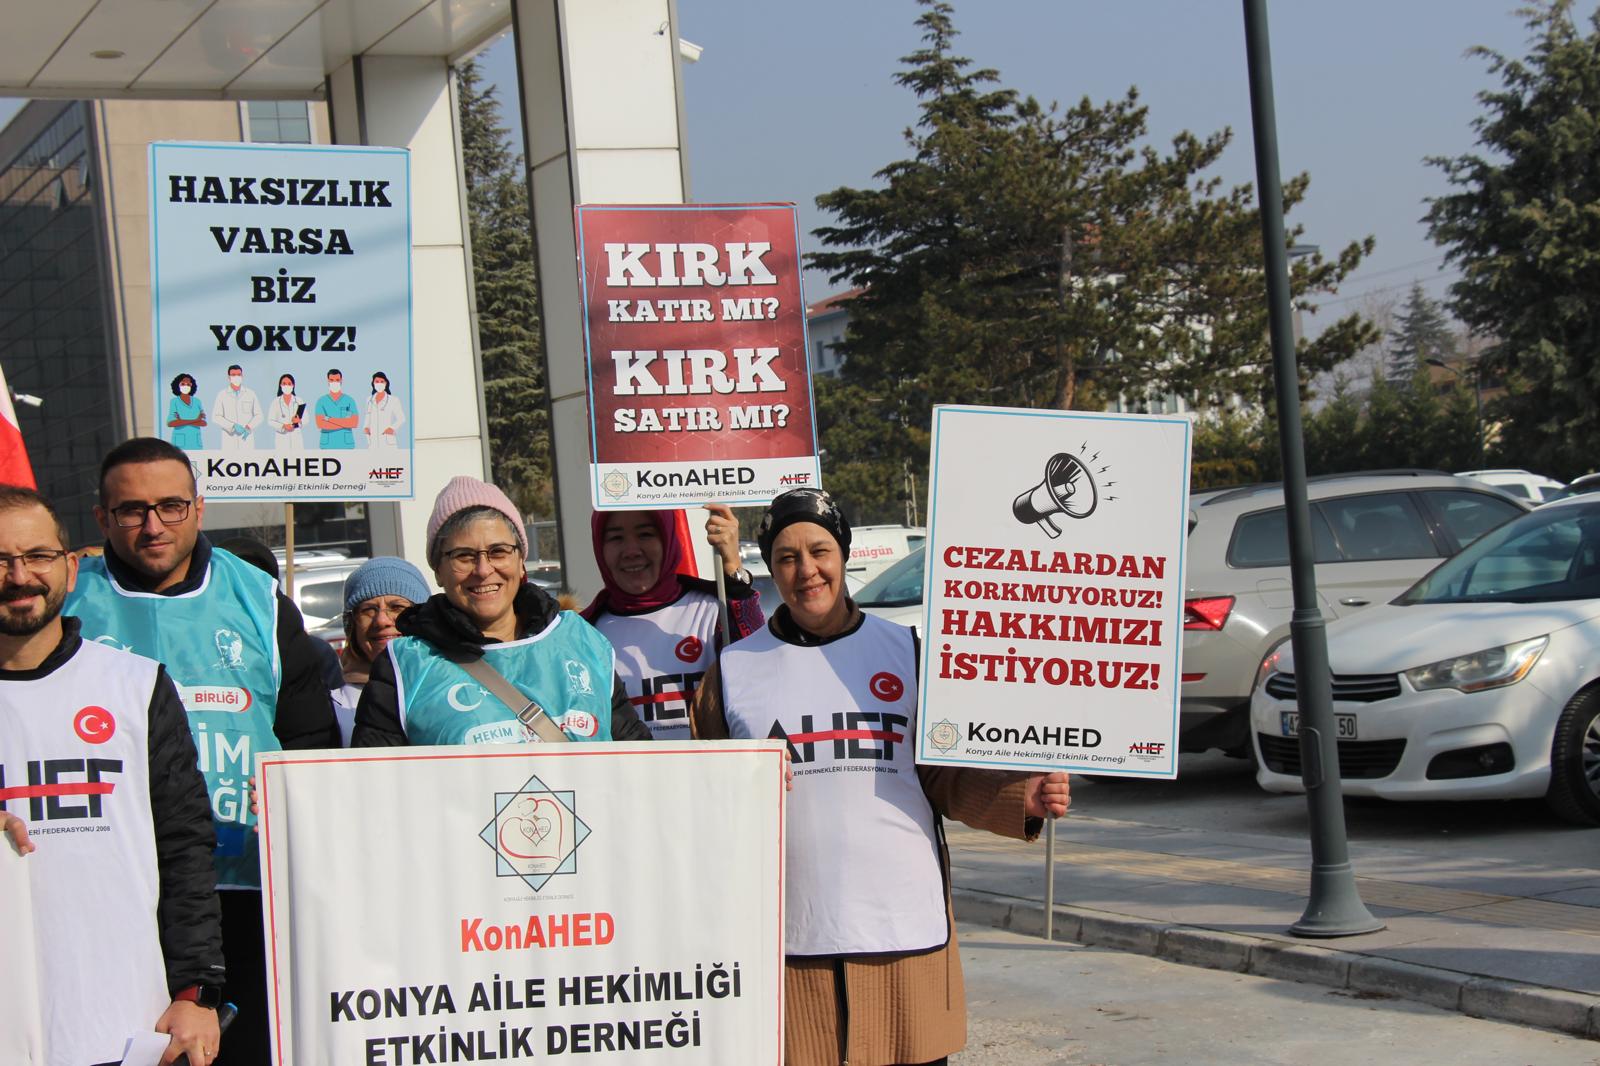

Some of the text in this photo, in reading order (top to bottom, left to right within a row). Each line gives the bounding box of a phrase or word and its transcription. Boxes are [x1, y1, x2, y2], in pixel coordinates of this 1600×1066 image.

[169, 175, 392, 207] HAKSIZLIK
[210, 226, 353, 255] VARSA
[604, 241, 777, 287] KIRK
[251, 267, 316, 304] BİZ
[607, 297, 779, 323] KATIR MI?
[210, 324, 357, 352] YOKUZ!
[611, 347, 786, 396] KIRK
[613, 404, 790, 433] SATIR MI?
[207, 458, 341, 477] KonAHED
[368, 467, 404, 479] AHEF
[636, 467, 755, 488] KonAHED
[779, 472, 811, 485] AHEF
[206, 484, 234, 492] Konya
[237, 483, 252, 491] Aile
[254, 483, 296, 492] Hekimliği
[299, 483, 330, 491] Etkinlik
[332, 483, 367, 492] Derneği
[636, 492, 661, 500] Konya
[717, 489, 746, 497] Etkinlik
[850, 545, 893, 559] enigün
[943, 545, 1167, 579] CEZALARDAN
[944, 579, 1163, 609] KORKMUYORUZ!
[941, 608, 1163, 646] HAKKIMIZI
[939, 643, 1161, 690] İSTİYORUZ!
[194, 690, 239, 705] BİRLİĞİ
[472, 726, 513, 743] HEKİM
[967, 721, 1102, 748] KonAHED
[1339, 717, 1354, 736] 50
[965, 747, 993, 757] Konya
[994, 748, 1012, 757] Aile
[1056, 752, 1090, 761] Etkinlik
[1091, 754, 1126, 764] Derneği
[1129, 742, 1165, 755] AHEF
[804, 765, 843, 776] DERNEKLERİ
[843, 765, 887, 773] FEDERASYONU
[28, 826, 41, 836] ERİ
[42, 826, 95, 836] FEDERASYONU
[461, 911, 615, 953] KonAHED
[330, 961, 741, 1023] KONYA AİLE HEKİMLİĞİ
[365, 1010, 701, 1066] ETKİNLİK DERNEĞİ
